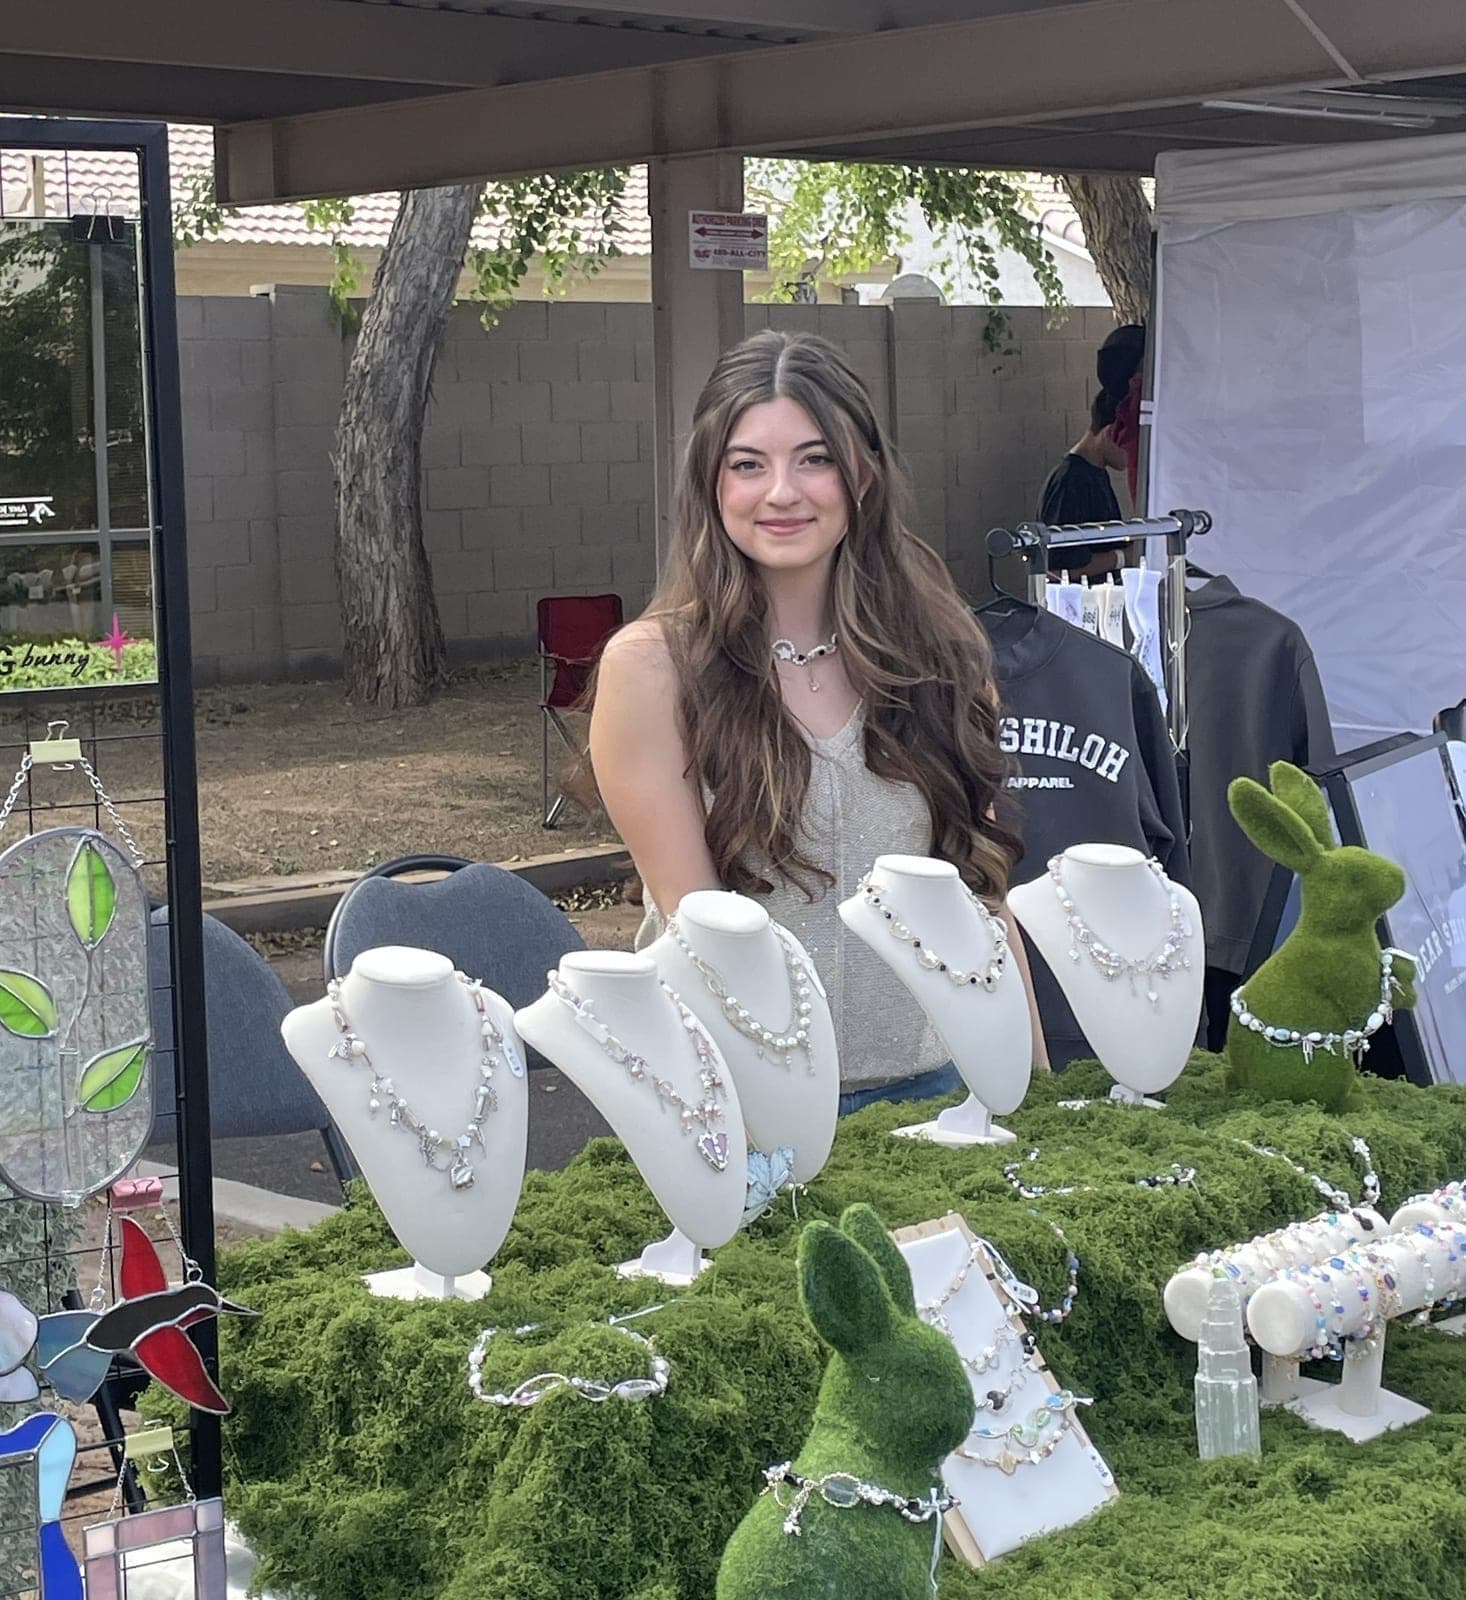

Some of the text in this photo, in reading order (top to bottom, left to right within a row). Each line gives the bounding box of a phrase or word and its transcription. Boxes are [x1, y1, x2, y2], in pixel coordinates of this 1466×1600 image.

[20, 643, 90, 678] bunny
[999, 717, 1130, 783] SHILOH
[1006, 776, 1075, 789] APPAREL
[1414, 929, 1444, 984] DEAR
